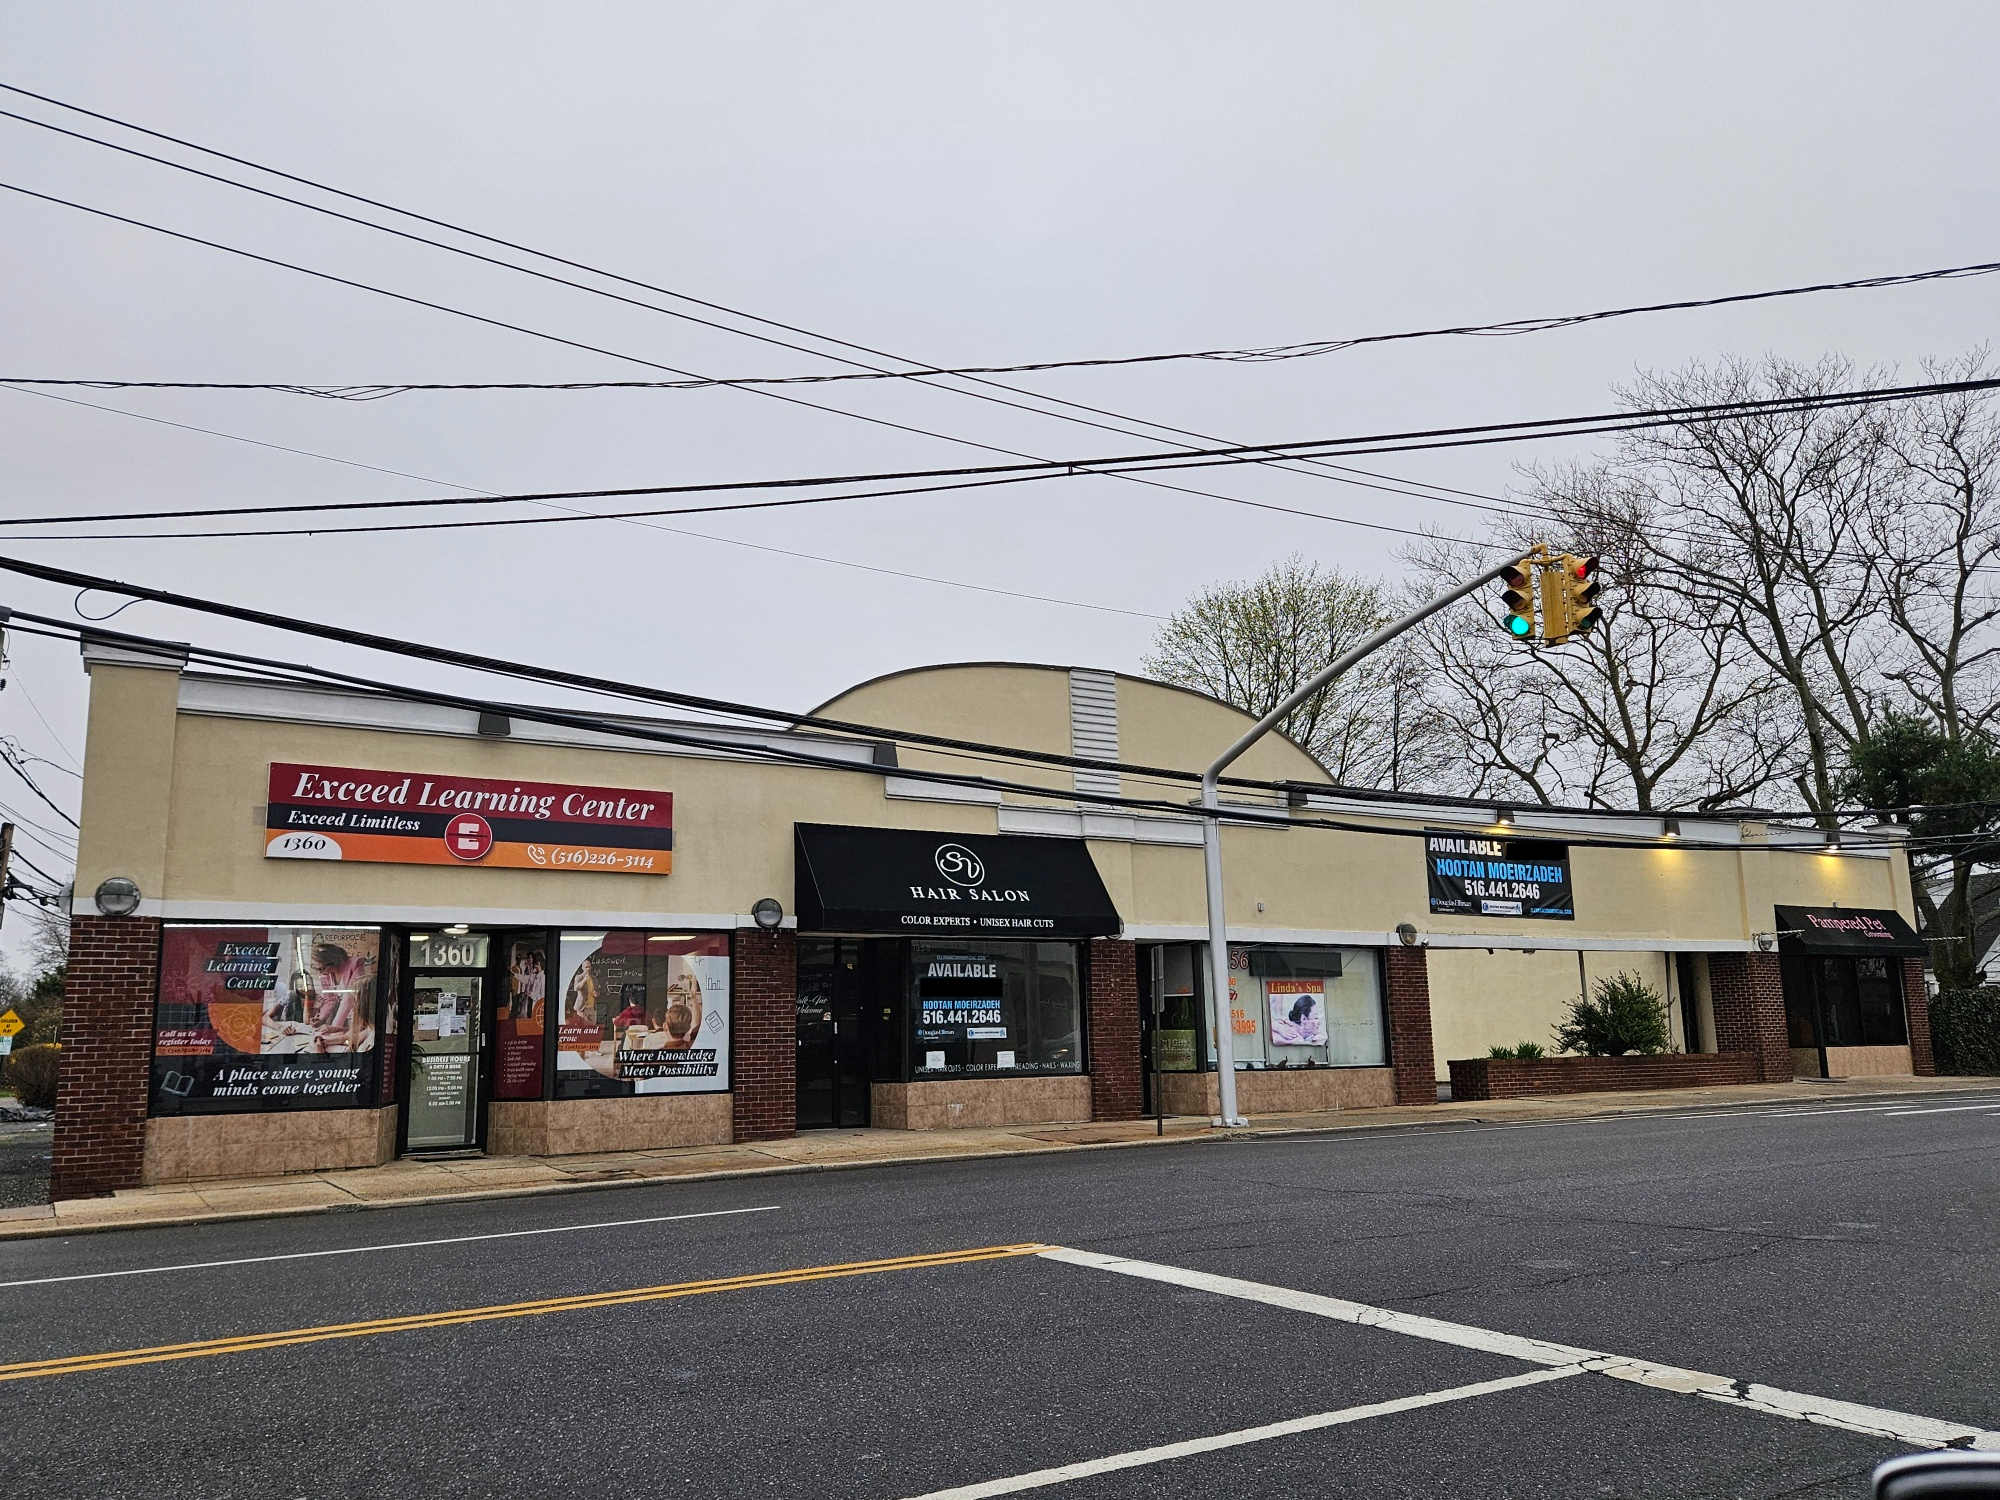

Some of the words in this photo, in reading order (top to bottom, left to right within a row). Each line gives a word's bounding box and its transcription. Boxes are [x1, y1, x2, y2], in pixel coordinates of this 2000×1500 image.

[291, 772, 412, 806] Exceed
[416, 782, 556, 820] Learning
[562, 793, 655, 821] Center
[287, 810, 347, 827] Exceed
[348, 813, 421, 831] Limitless
[283, 835, 326, 852] 1360
[1429, 837, 1503, 857] AVAILABLE
[551, 847, 654, 869] (516)226-3114
[1436, 858, 1485, 879] HOOTAN
[1488, 862, 1563, 884] MOEIRZADEH
[909, 886, 962, 900] HAIR
[968, 888, 1031, 902] SALON
[1464, 879, 1540, 900] 516.441.2646
[901, 915, 932, 925] COLOR
[933, 916, 971, 926] EXPERTS
[980, 918, 1011, 927] UNISEX
[1012, 918, 1033, 928] HAIR
[1033, 919, 1054, 928] CUTS
[1806, 914, 1868, 933] Pampered
[1861, 916, 1887, 930] Pet
[324, 933, 366, 942] REPURPOSE
[223, 943, 273, 956] Exceed
[421, 940, 475, 966] 1360
[206, 959, 272, 975] Learning
[927, 963, 997, 978] AVAILABLE
[226, 976, 274, 989] Center
[1271, 982, 1303, 993] Linda's
[1306, 982, 1322, 994] Spa
[796, 1004, 823, 1015] Welcome
[922, 1000, 953, 1010] HOOTAN
[954, 1000, 1001, 1009] MOEIRZADEH
[922, 1009, 1001, 1024] 516.441.2646
[159, 1030, 177, 1038] Call
[558, 1026, 582, 1035] Learn
[583, 1026, 599, 1034] and
[1231, 1020, 1256, 1034] -3995
[158, 1038, 189, 1046] register
[190, 1038, 212, 1046] today
[558, 1036, 578, 1044] grow
[422, 1055, 449, 1064] BUSINESS
[450, 1055, 471, 1063] HOURS
[618, 1050, 654, 1061] Where
[657, 1049, 714, 1062] Knowledge
[622, 1065, 655, 1077] Meets
[657, 1064, 716, 1077] Possibility.
[965, 1063, 983, 1072] COLOR
[1041, 1061, 1057, 1069] NAILS
[1060, 1061, 1081, 1069] WAXING
[212, 1069, 225, 1081] A
[227, 1067, 268, 1083] place
[270, 1066, 314, 1080] where
[315, 1067, 360, 1081] young
[212, 1083, 259, 1097] minds
[261, 1084, 300, 1096] come
[302, 1081, 361, 1096] together
